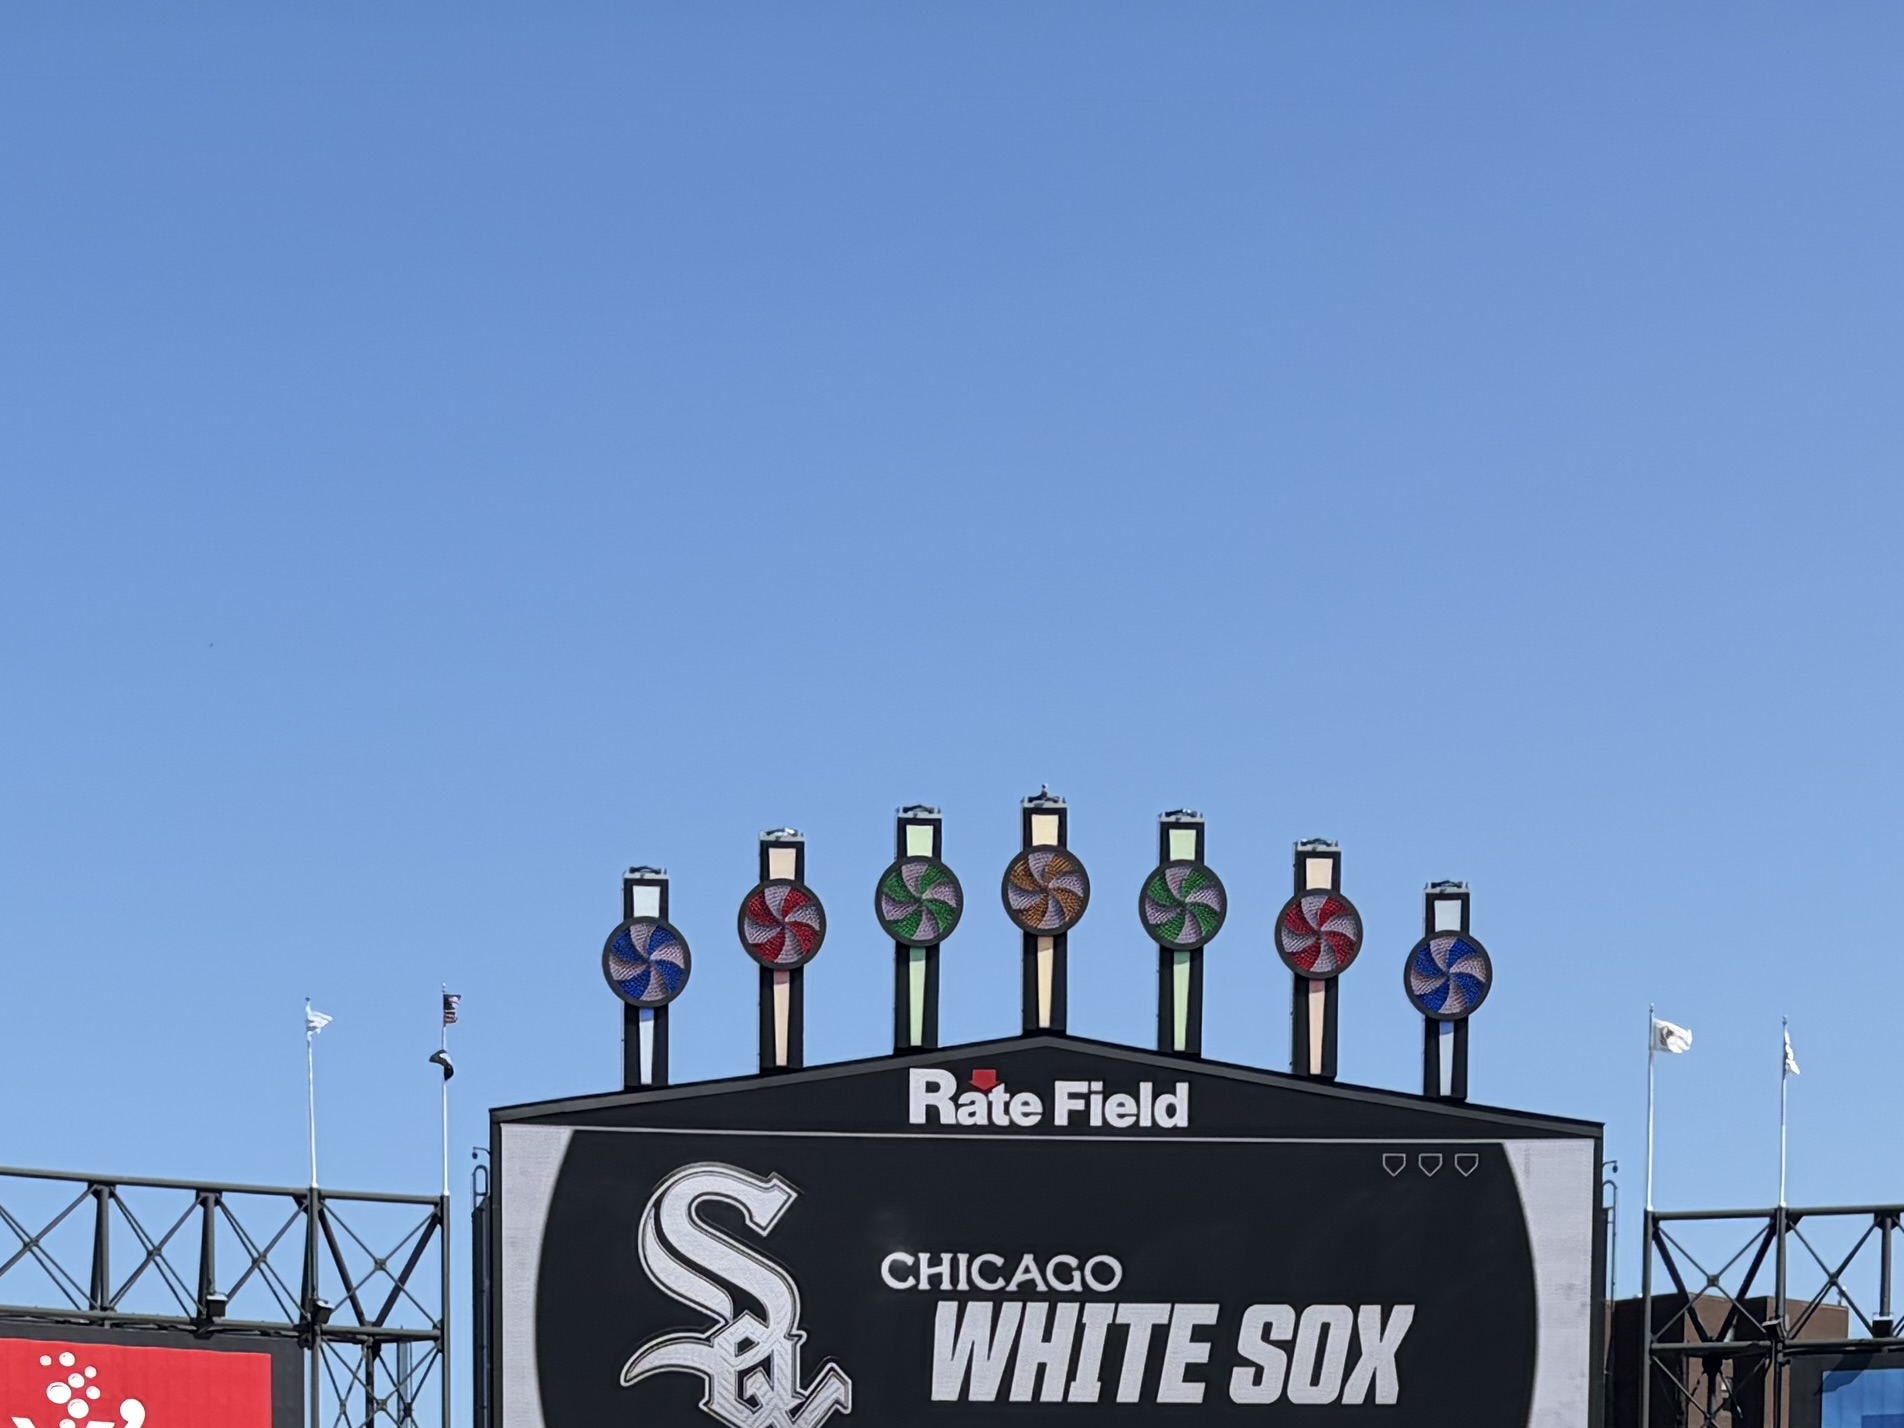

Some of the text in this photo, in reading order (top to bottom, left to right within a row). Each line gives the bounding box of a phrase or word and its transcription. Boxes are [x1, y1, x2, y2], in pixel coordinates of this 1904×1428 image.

[909, 1068, 1190, 1130] Rate Field
[880, 1252, 1122, 1294] CHICAGO
[930, 1301, 1415, 1406] WHITE SOX
